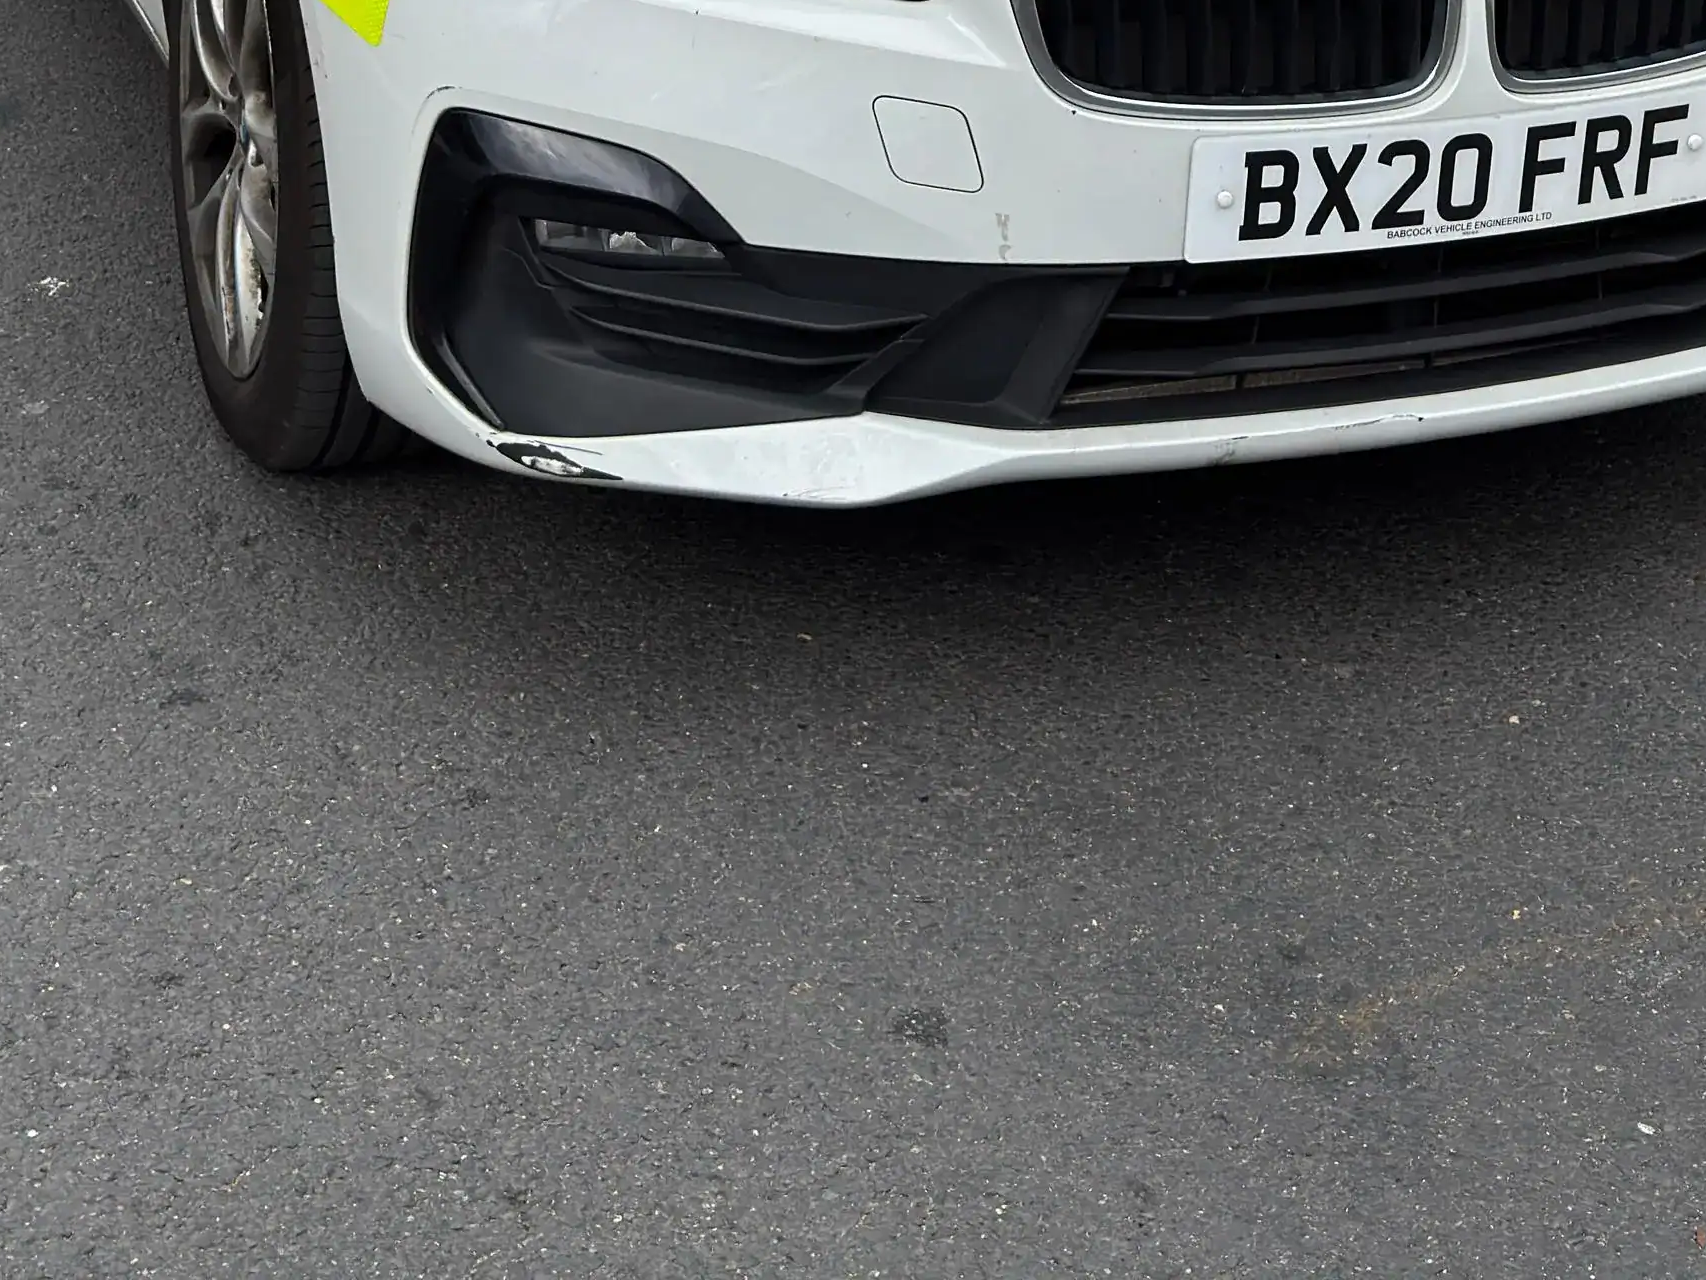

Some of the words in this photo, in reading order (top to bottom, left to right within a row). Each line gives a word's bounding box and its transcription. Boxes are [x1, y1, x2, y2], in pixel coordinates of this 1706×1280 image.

[1237, 131, 1494, 242] BX20
[1518, 102, 1690, 214] FRF
[1387, 224, 1433, 239] BABCOCK
[1434, 222, 1473, 234] VEHICLE
[1474, 214, 1534, 229] ENGINEERING
[1535, 211, 1552, 222] LTD
